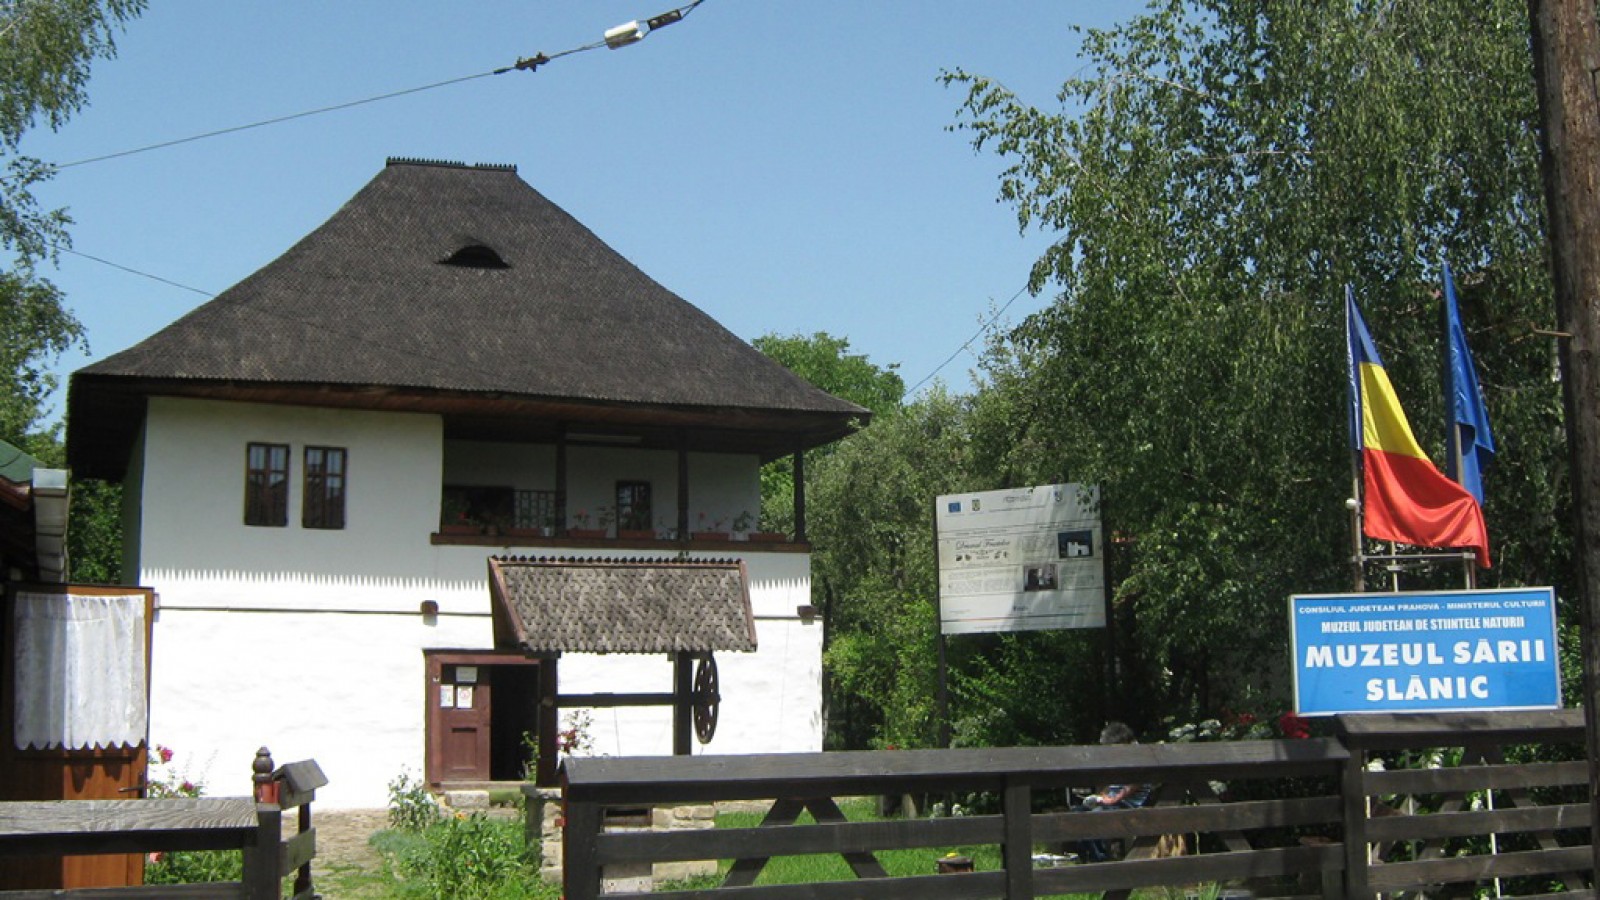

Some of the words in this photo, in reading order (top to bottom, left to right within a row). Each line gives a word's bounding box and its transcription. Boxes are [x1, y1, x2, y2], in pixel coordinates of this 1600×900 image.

[1299, 605, 1346, 614] CONSILIUL
[1349, 604, 1395, 613] JUDETEAN
[1398, 603, 1440, 611] PRAHOVA
[1446, 601, 1501, 610] MINISTERUL
[1503, 599, 1546, 609] CULTURII
[1321, 621, 1361, 633] MUZEUL
[1363, 619, 1413, 632] JUDETEAN
[1415, 618, 1429, 631] DE
[1430, 617, 1481, 630] STIINTELE
[1482, 616, 1525, 629] NATURII
[1305, 642, 1445, 668] MUZEUL
